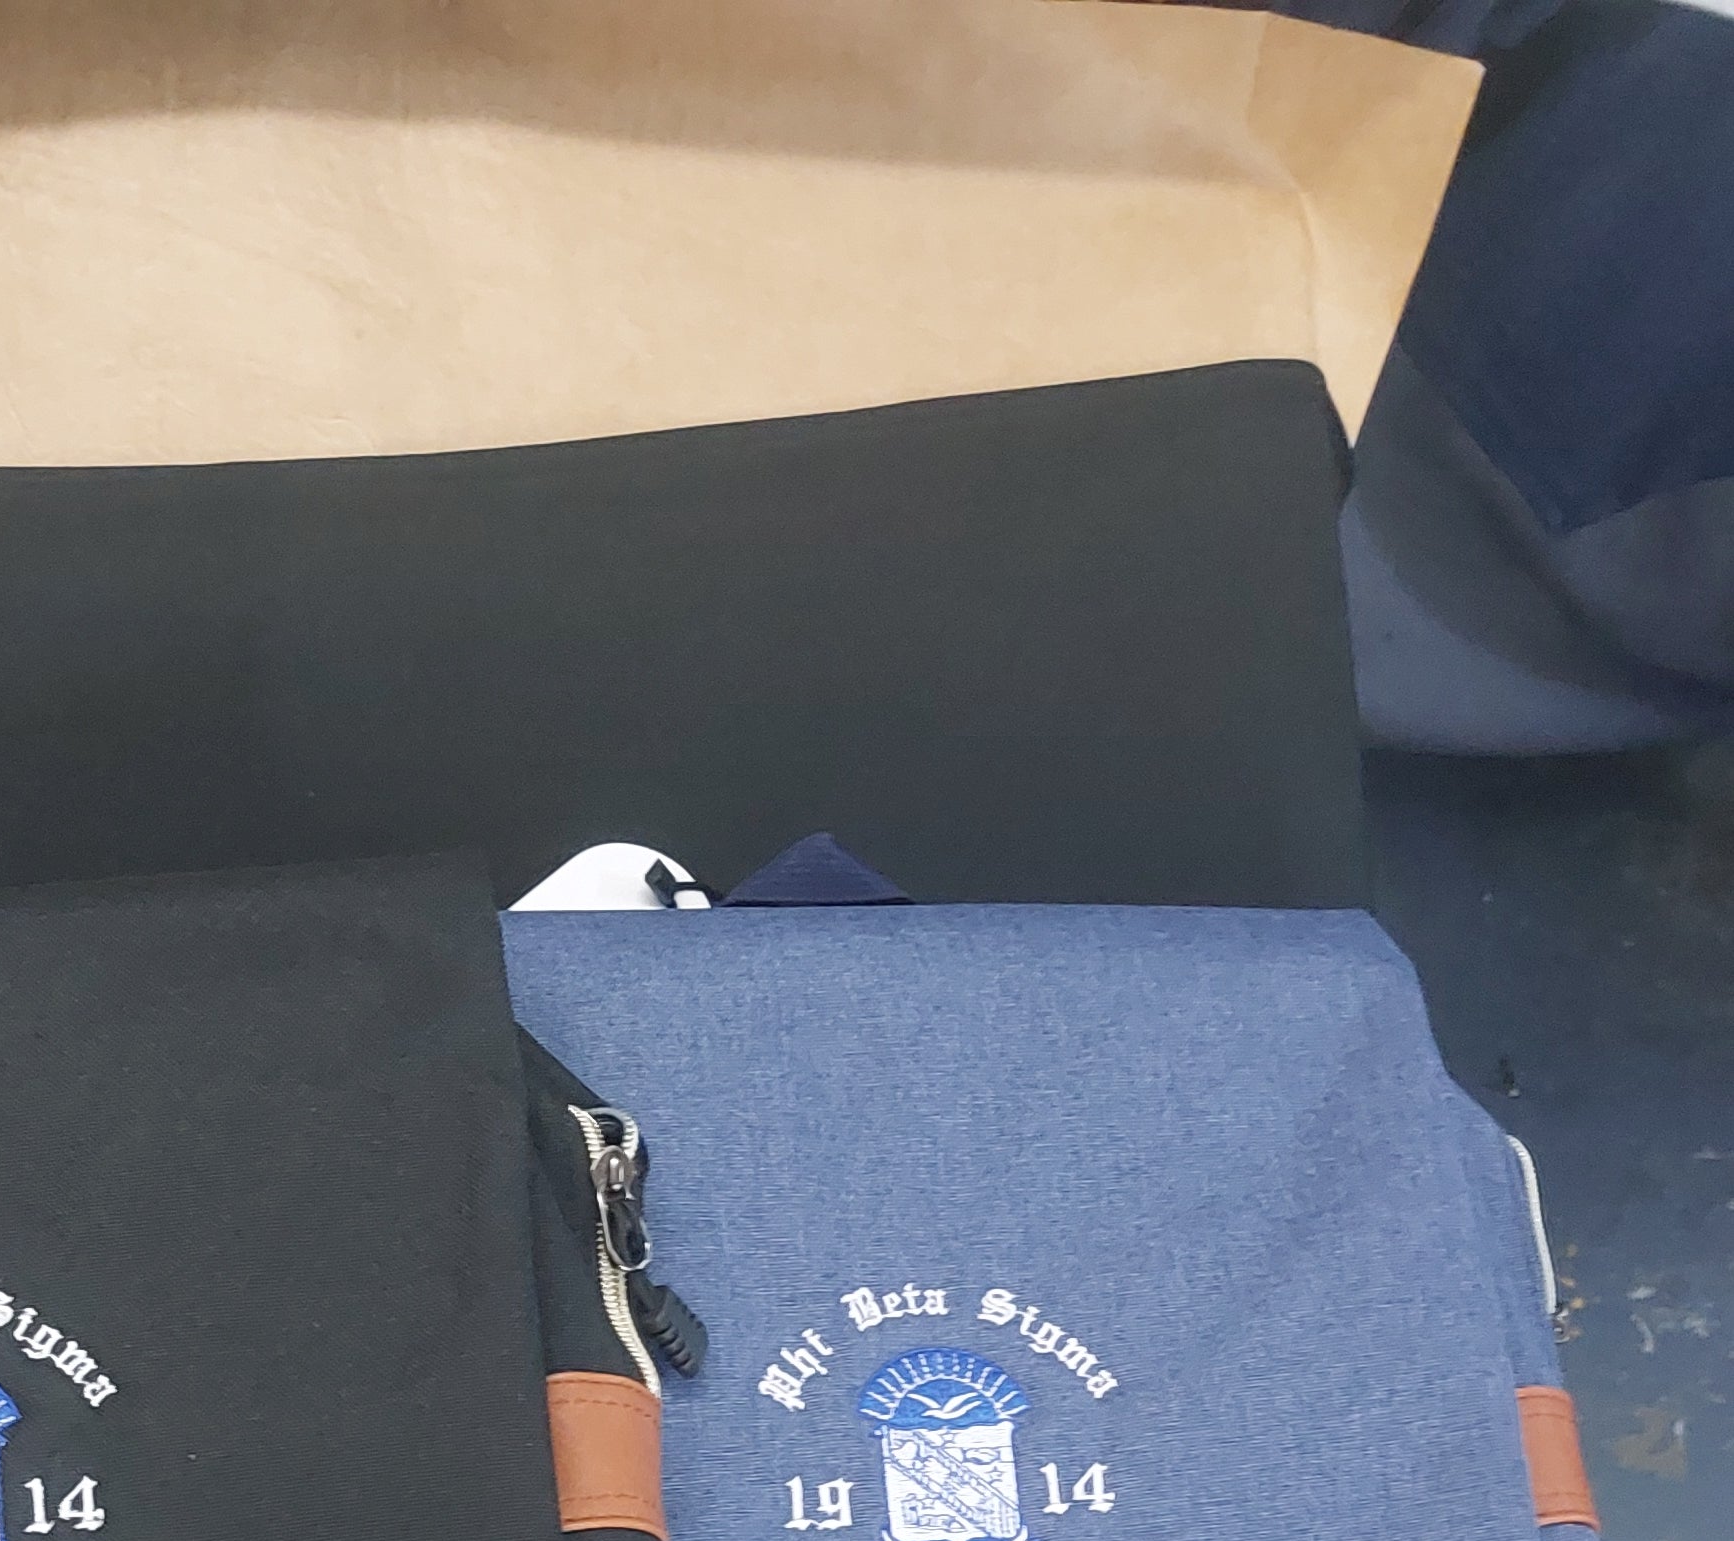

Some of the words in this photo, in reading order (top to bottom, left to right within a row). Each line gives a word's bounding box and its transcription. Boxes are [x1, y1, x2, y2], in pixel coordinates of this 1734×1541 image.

[758, 1329, 833, 1412] Phi
[840, 1283, 949, 1331] Beta
[977, 1288, 1119, 1399] Sigma
[23, 1475, 105, 1534] 14
[784, 1476, 854, 1530] 19
[1040, 1462, 1116, 1514] 14
